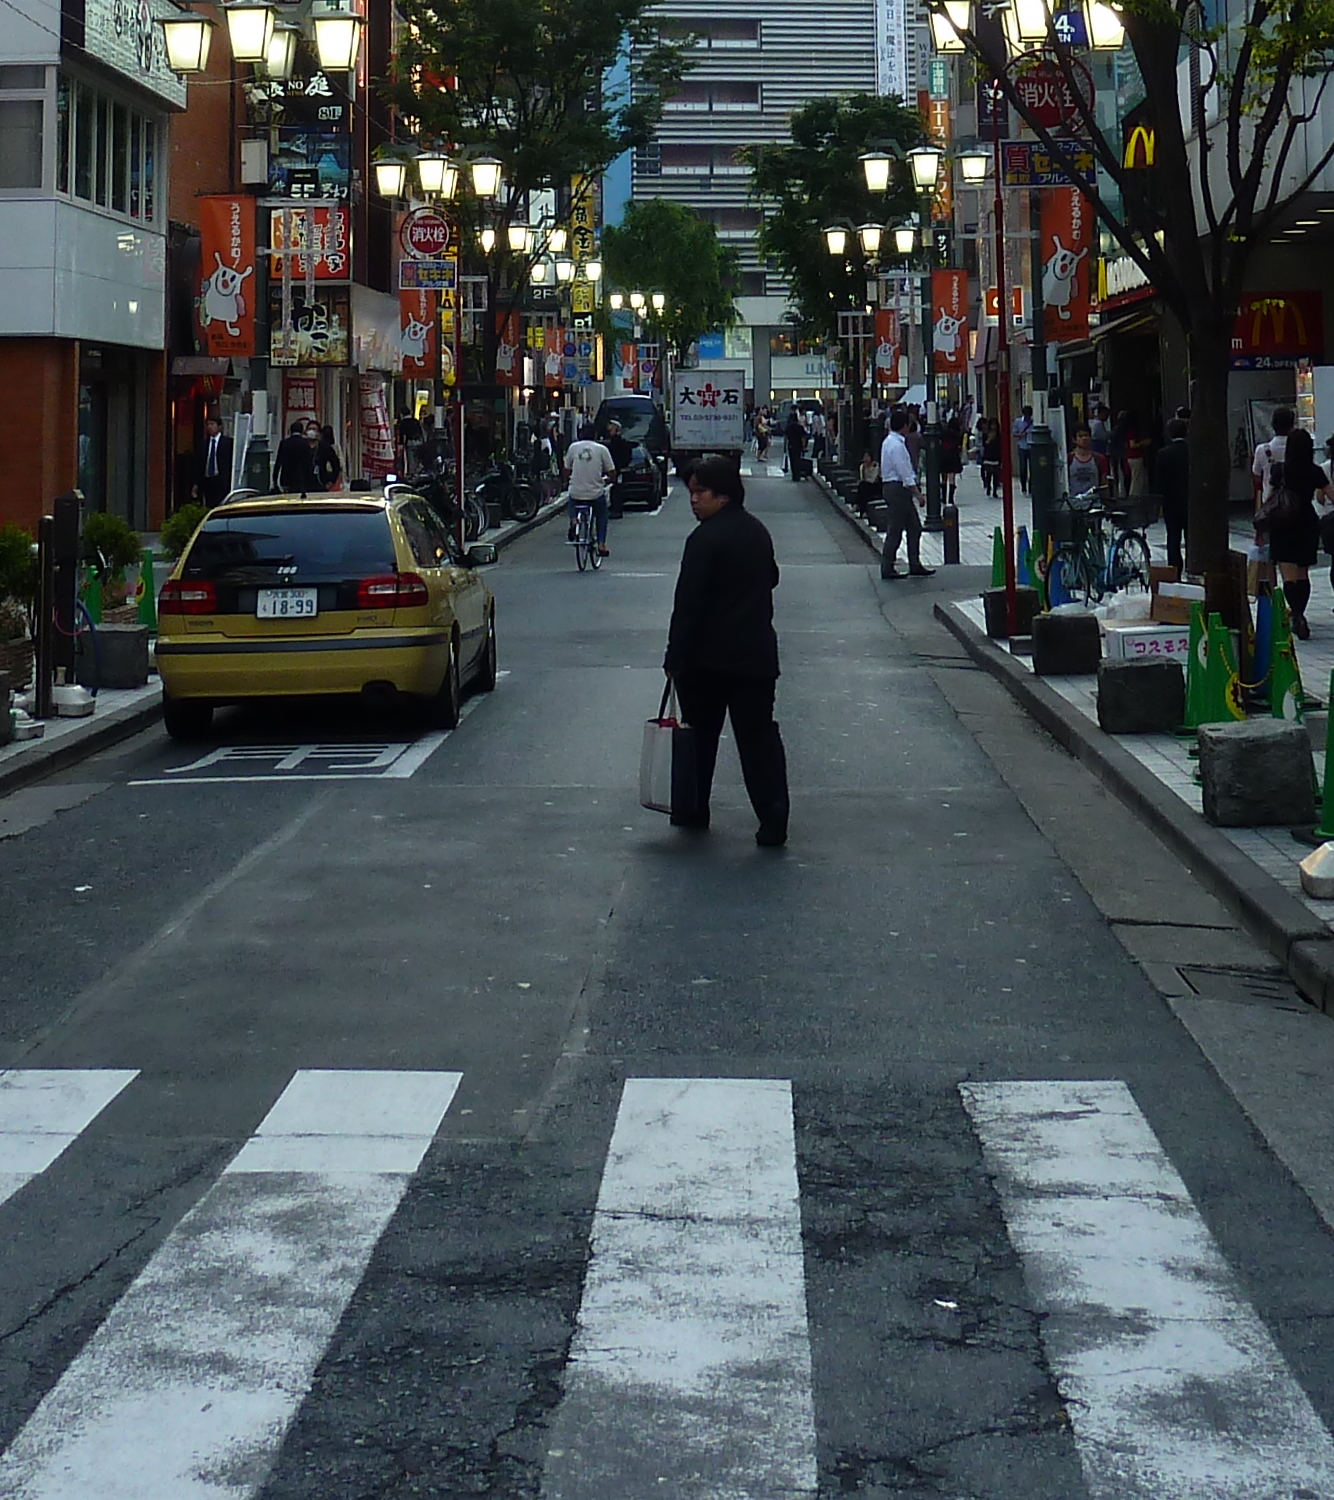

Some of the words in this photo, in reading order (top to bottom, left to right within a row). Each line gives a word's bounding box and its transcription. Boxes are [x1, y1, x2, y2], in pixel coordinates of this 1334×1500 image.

[290, 183, 316, 199] 5F
[412, 226, 446, 242] 消火栓
[679, 386, 697, 405] 大
[722, 386, 740, 404] 石
